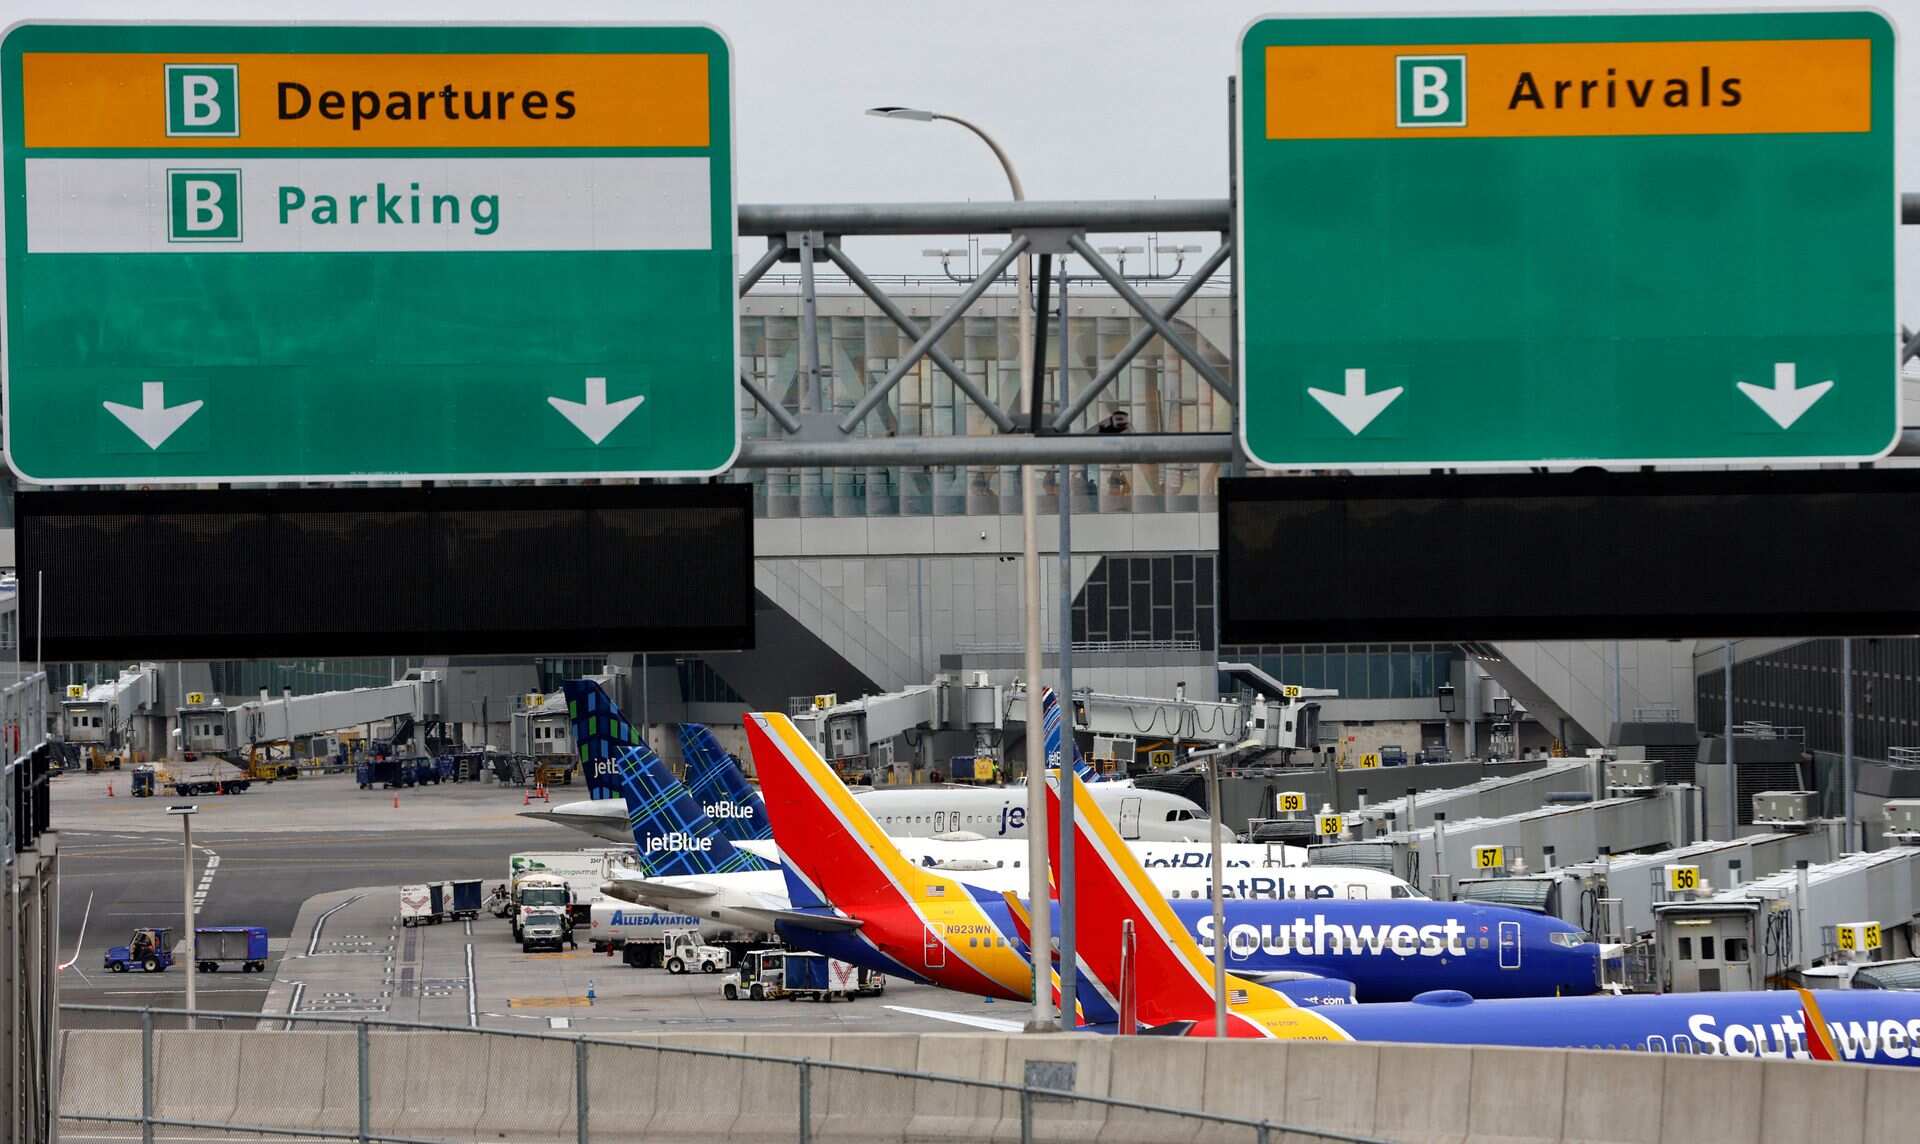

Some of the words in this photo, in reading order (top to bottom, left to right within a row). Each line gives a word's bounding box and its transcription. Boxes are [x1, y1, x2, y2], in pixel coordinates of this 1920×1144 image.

[1413, 66, 1450, 117] B
[1507, 65, 1743, 110] Arrivals
[182, 75, 222, 126] B
[277, 80, 577, 130] Departures
[185, 180, 224, 231] B
[278, 182, 501, 234] Parking
[1285, 687, 1299, 697] 30
[1153, 752, 1170, 765] 40
[1363, 755, 1376, 768] 41
[1284, 795, 1299, 810] 59
[1324, 817, 1338, 834] 58
[645, 832, 713, 856] jetBlue
[1482, 848, 1497, 867] 57
[1677, 869, 1693, 889] 56
[946, 924, 992, 935] N923WN
[1196, 914, 1467, 957] Southwest
[1841, 928, 1854, 949] 55
[1866, 925, 1878, 948] 55
